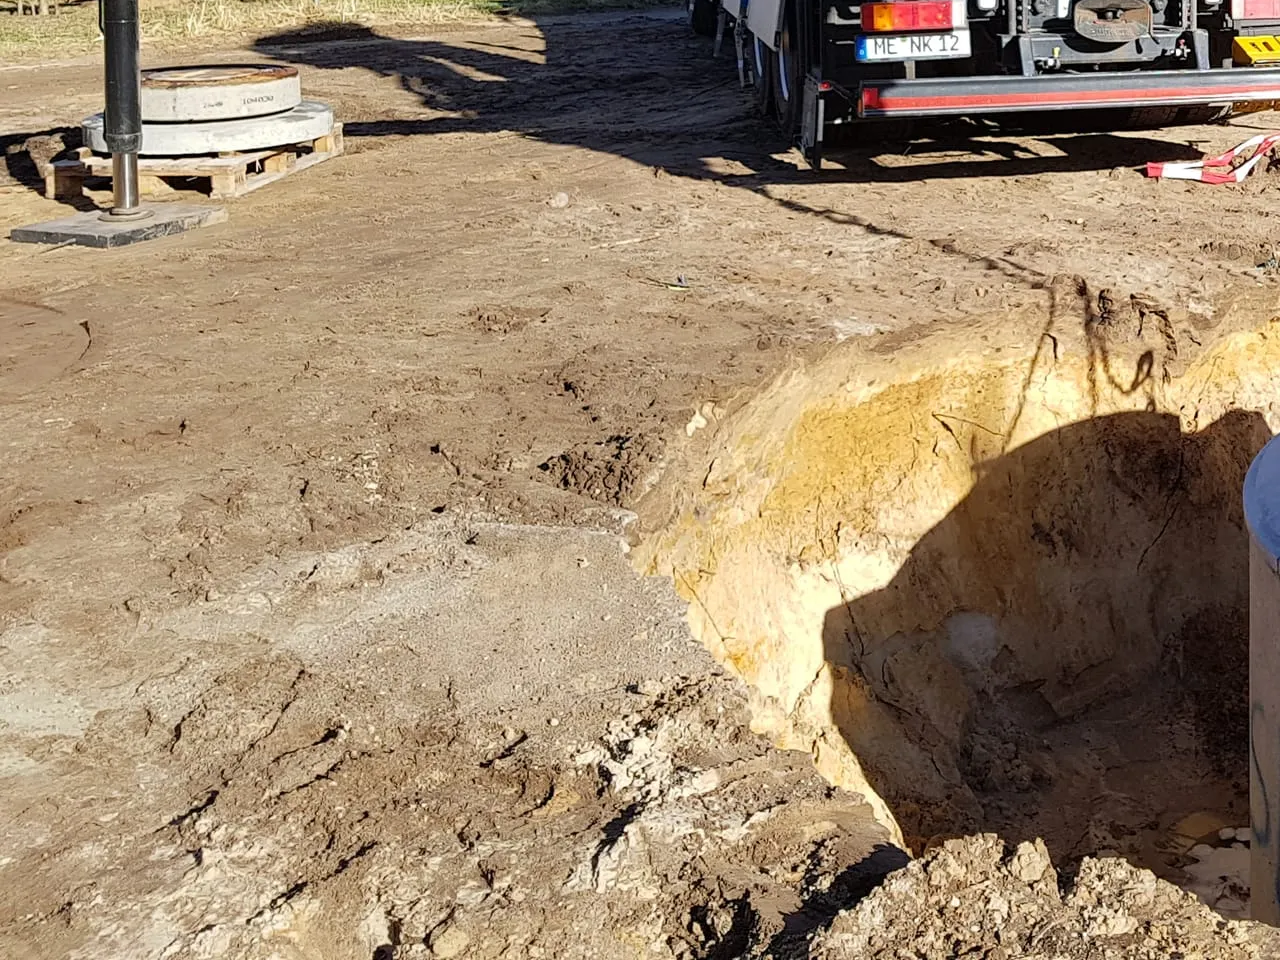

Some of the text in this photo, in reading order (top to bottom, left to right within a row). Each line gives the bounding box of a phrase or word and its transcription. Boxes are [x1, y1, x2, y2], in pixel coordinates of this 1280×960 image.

[874, 34, 960, 55] ME NK 12
